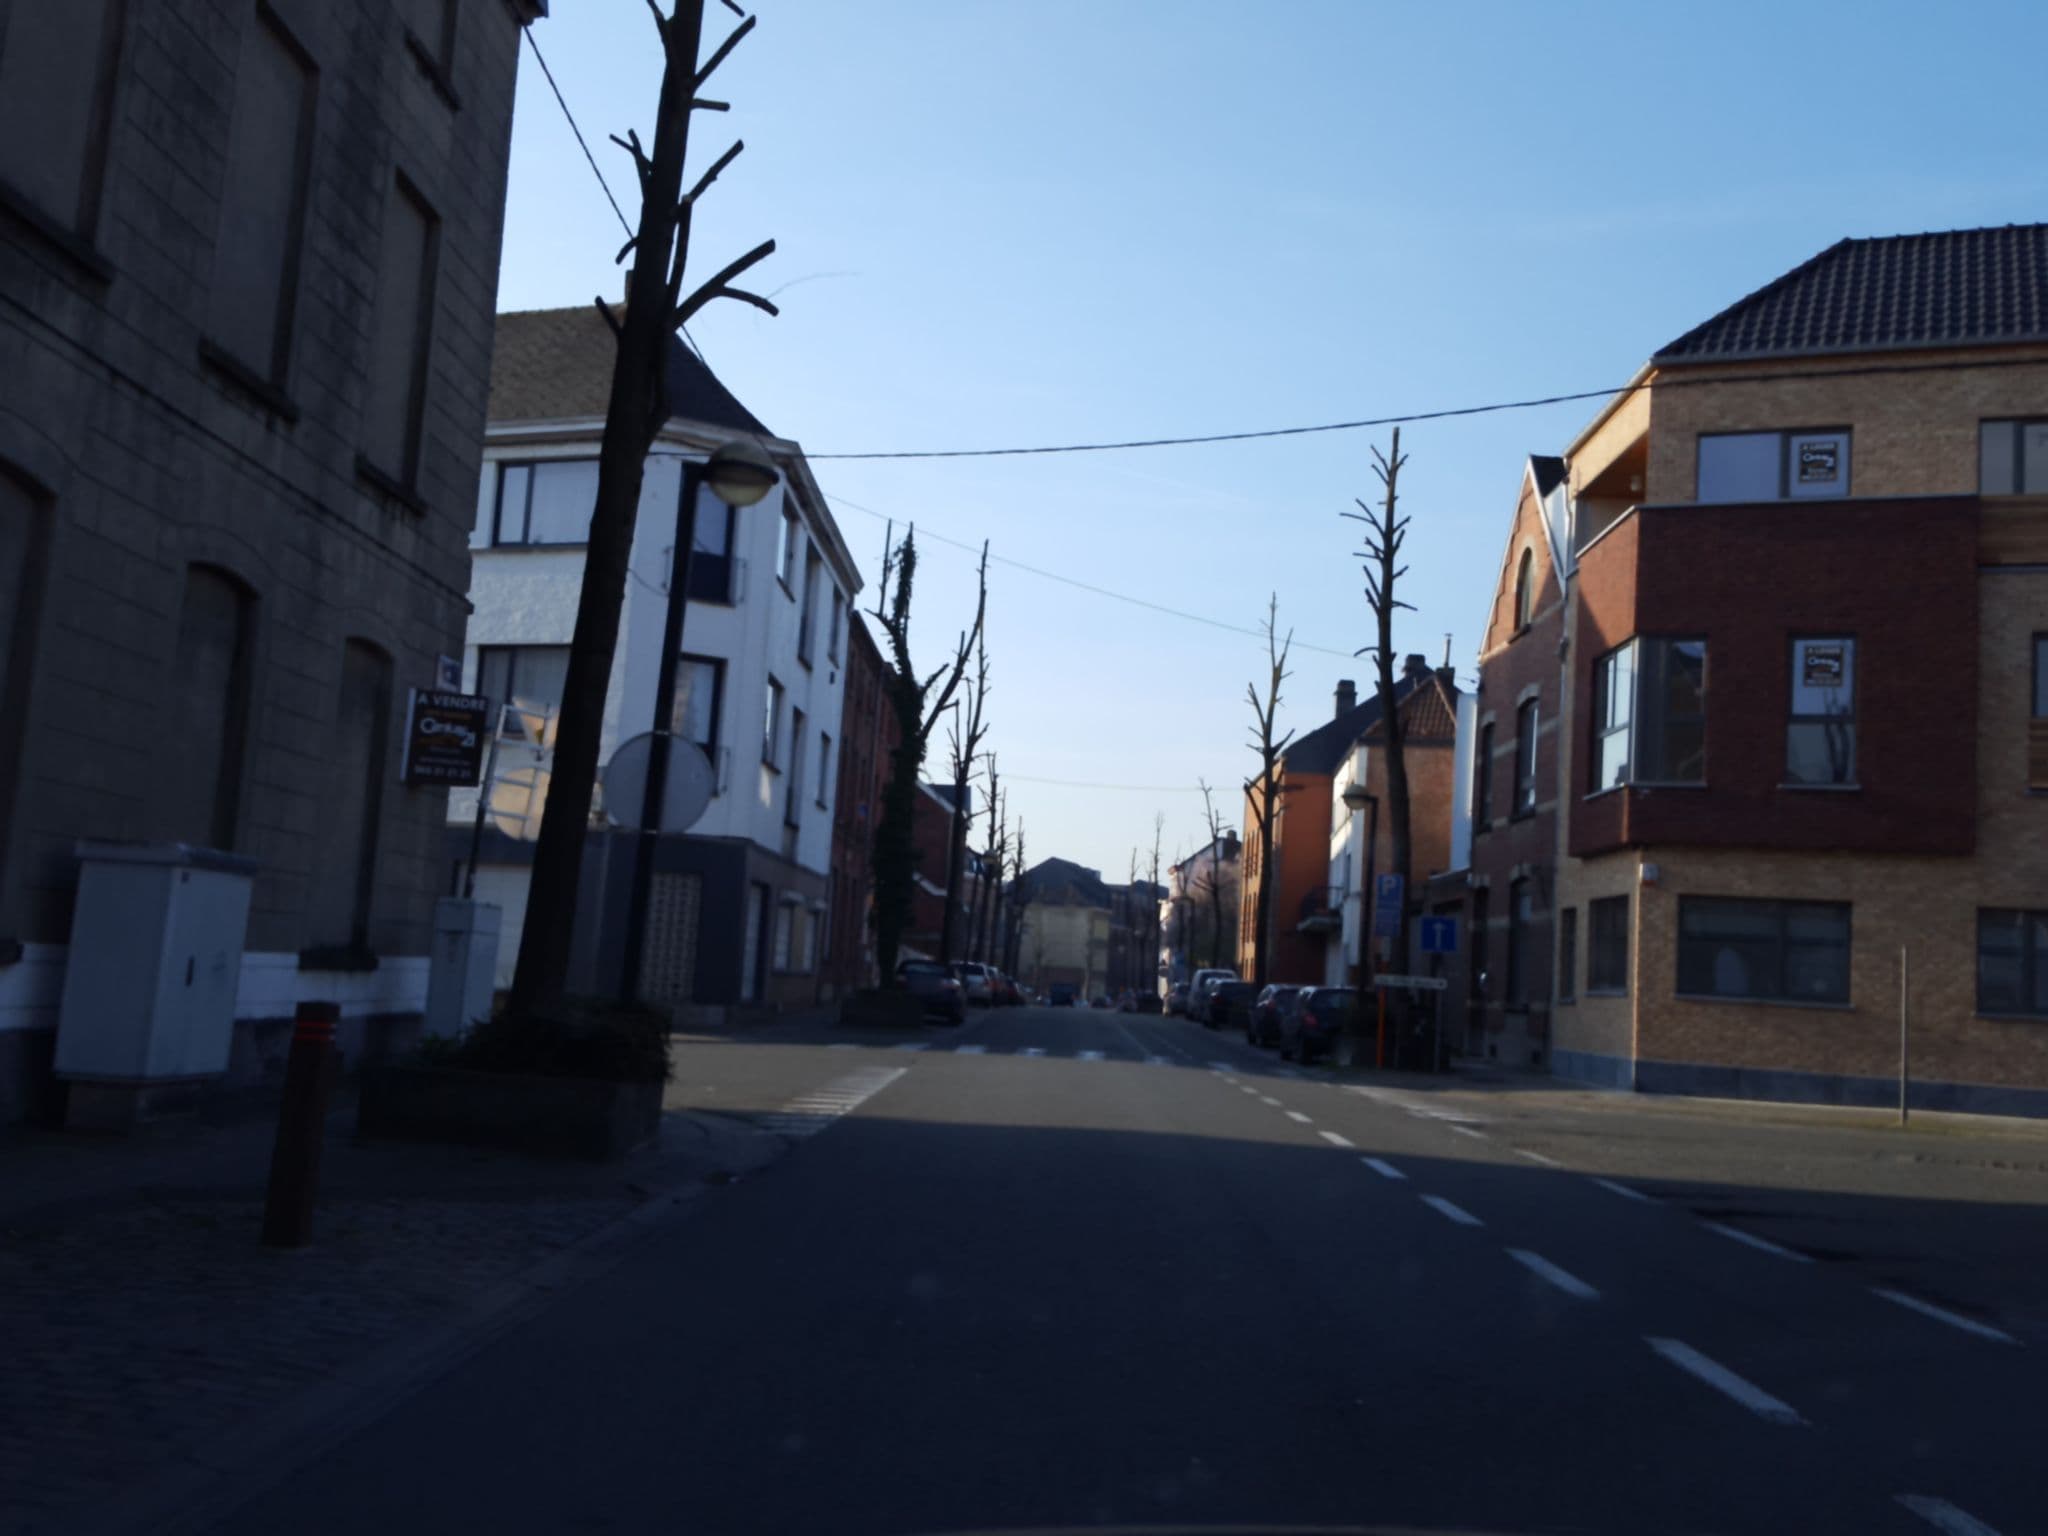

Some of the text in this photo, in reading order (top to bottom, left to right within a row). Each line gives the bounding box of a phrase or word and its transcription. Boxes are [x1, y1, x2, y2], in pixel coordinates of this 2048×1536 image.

[419, 692, 485, 711] A VENDRE
[1382, 875, 1396, 896] P
